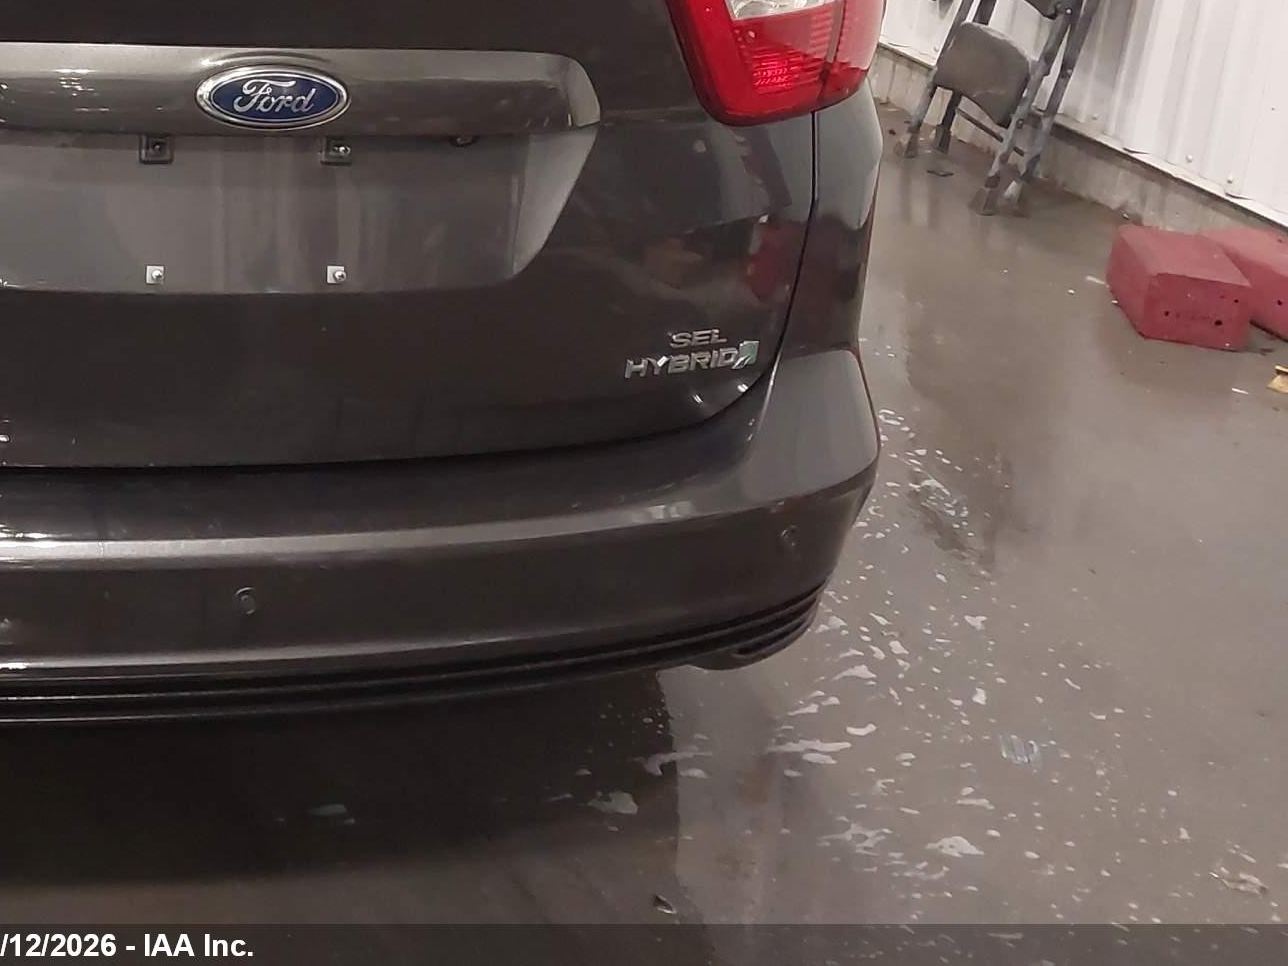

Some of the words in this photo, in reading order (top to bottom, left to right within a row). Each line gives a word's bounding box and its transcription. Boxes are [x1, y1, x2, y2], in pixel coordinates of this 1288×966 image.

[233, 79, 316, 113] Ford
[669, 328, 727, 348] SEL
[624, 347, 739, 379] HYBRID
